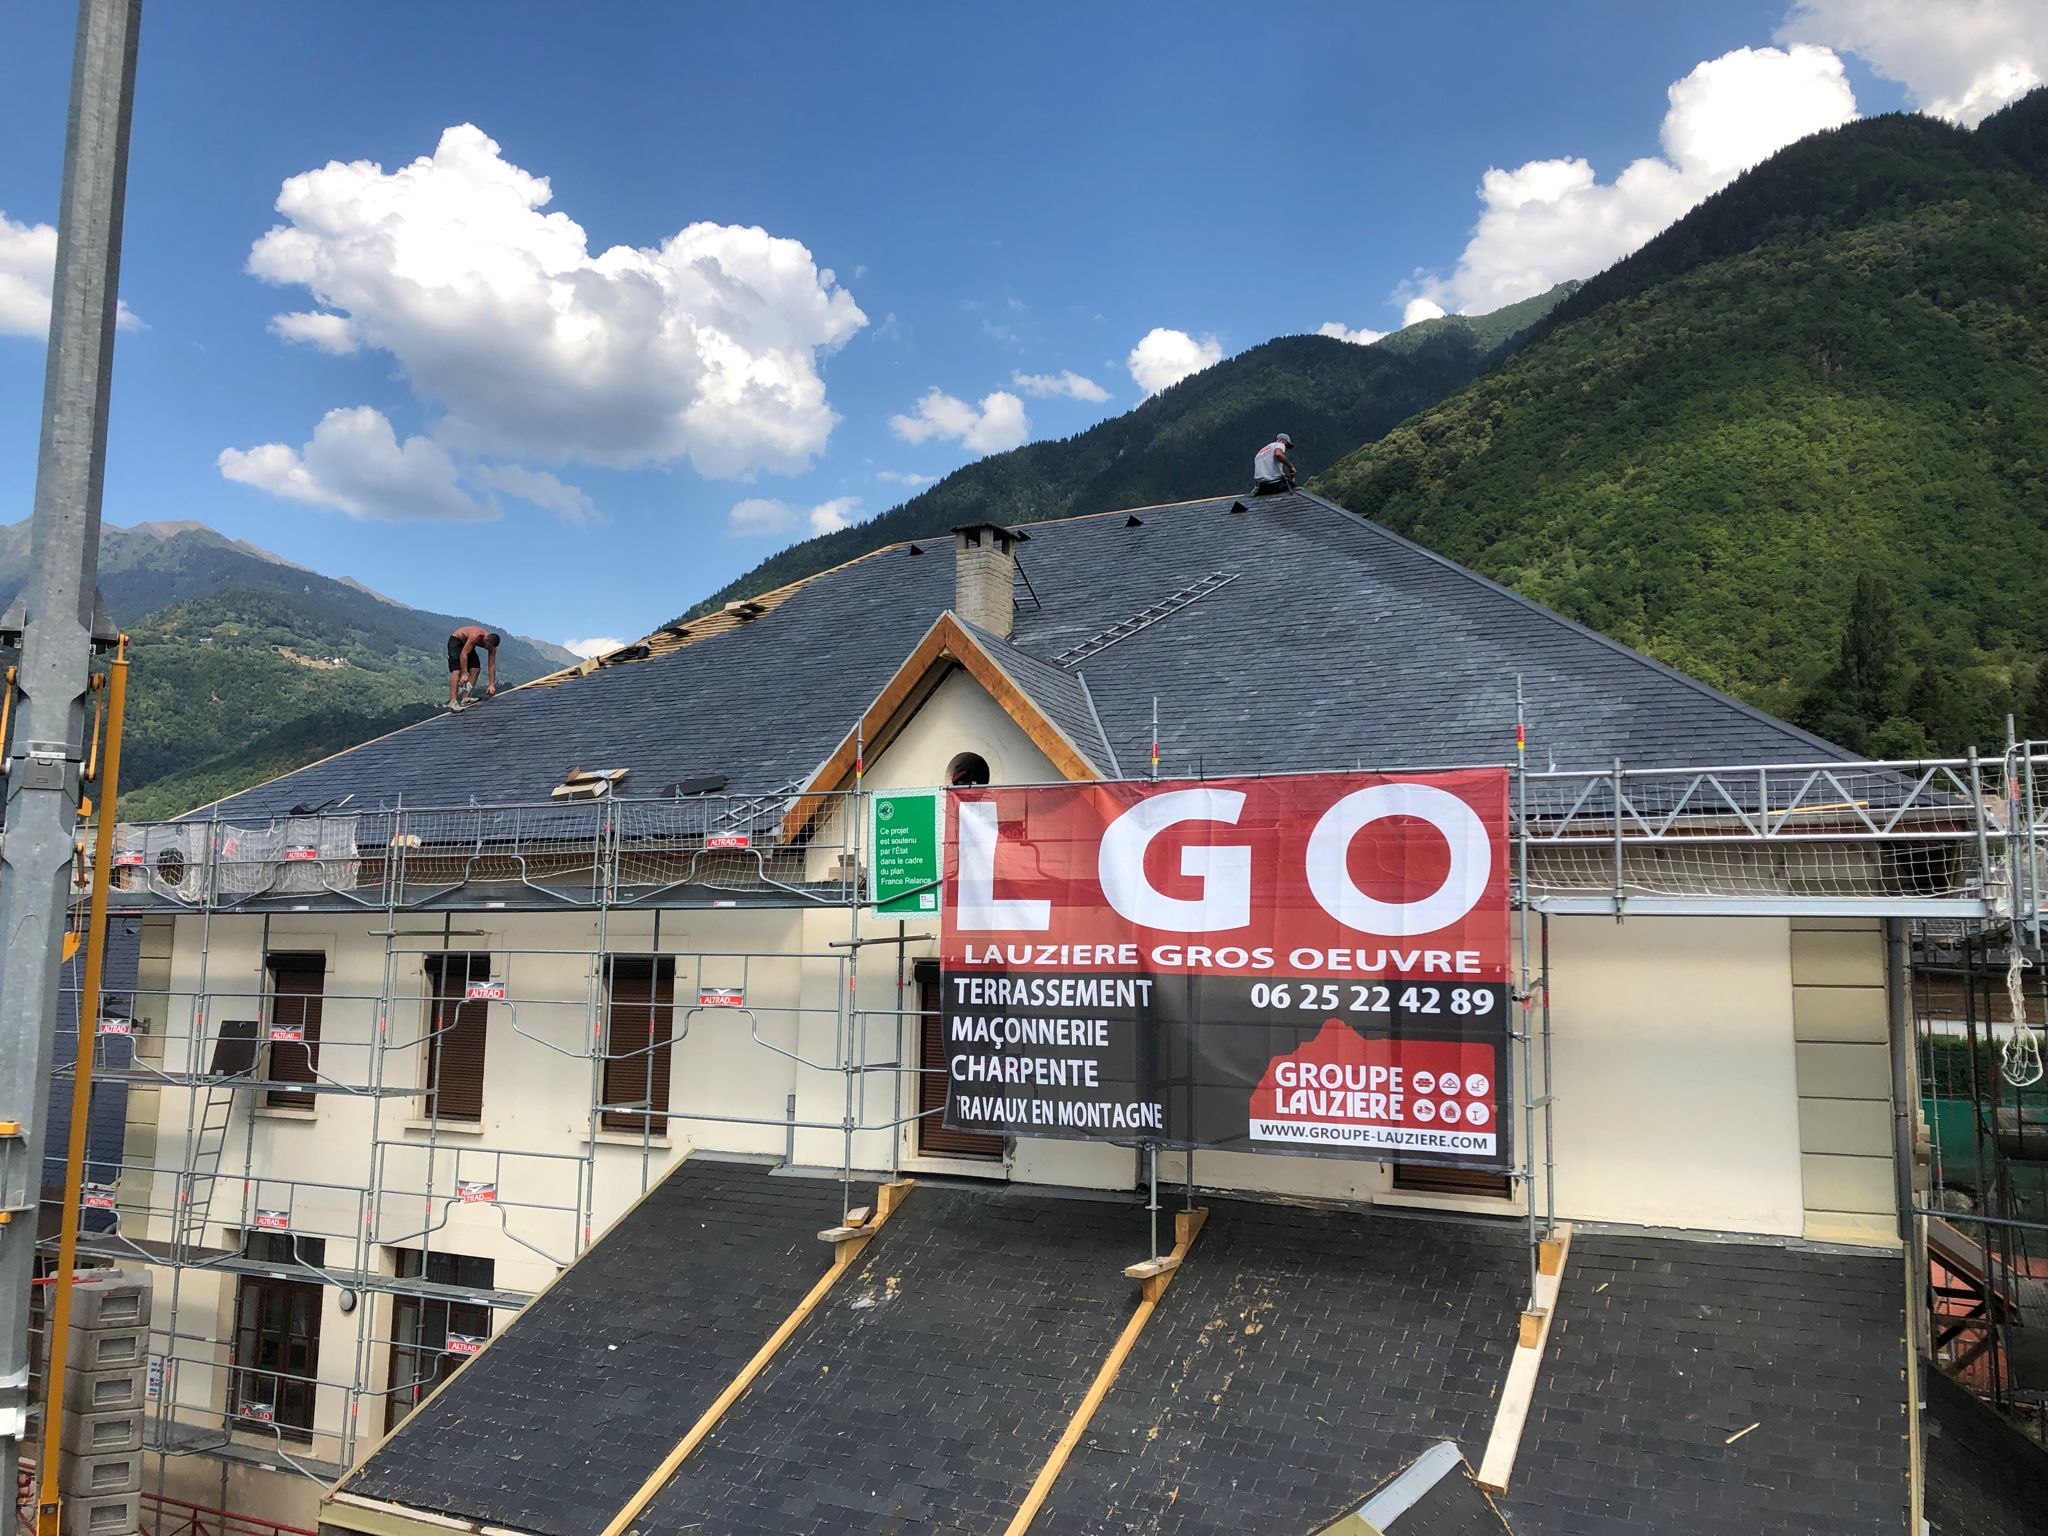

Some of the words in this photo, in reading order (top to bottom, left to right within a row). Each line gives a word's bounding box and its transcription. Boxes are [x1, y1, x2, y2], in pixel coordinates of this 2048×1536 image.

[880, 827, 889, 835] Ce
[891, 827, 909, 836] projet
[711, 838, 736, 846] ALTRAD
[891, 837, 917, 845] soutenu
[880, 848, 890, 856] par
[892, 846, 908, 855] l'État
[957, 783, 1491, 936] LGO
[891, 868, 904, 876] plan
[965, 944, 1138, 965] LAUZIERE
[1151, 945, 1275, 968] GROS
[1289, 948, 1481, 973] OEUVRE
[470, 989, 500, 998] ALTRAD
[704, 996, 730, 1004] ALTRAD
[954, 978, 1152, 1007] TERRASSEMENT
[1251, 983, 1290, 1009] 06
[1299, 984, 1339, 1010] 25
[1350, 986, 1390, 1012] 22
[1399, 987, 1441, 1014] 42
[1451, 988, 1494, 1015] 89
[103, 1025, 126, 1033] ALTRAD
[951, 1016, 1109, 1050] MAÇONNERIE
[951, 1055, 1098, 1087] CHARPENTE
[1275, 1062, 1403, 1092] GROUPE
[1275, 1088, 1404, 1120] LAUZIERE
[1032, 1099, 1054, 1125] EN
[1058, 1101, 1163, 1129] MONTAGNE
[1260, 1123, 1488, 1150] WWW.GROUPE-LAUZIERE.COM
[258, 1217, 279, 1226] ALTRAD
[451, 1342, 476, 1352] ALTRAD
